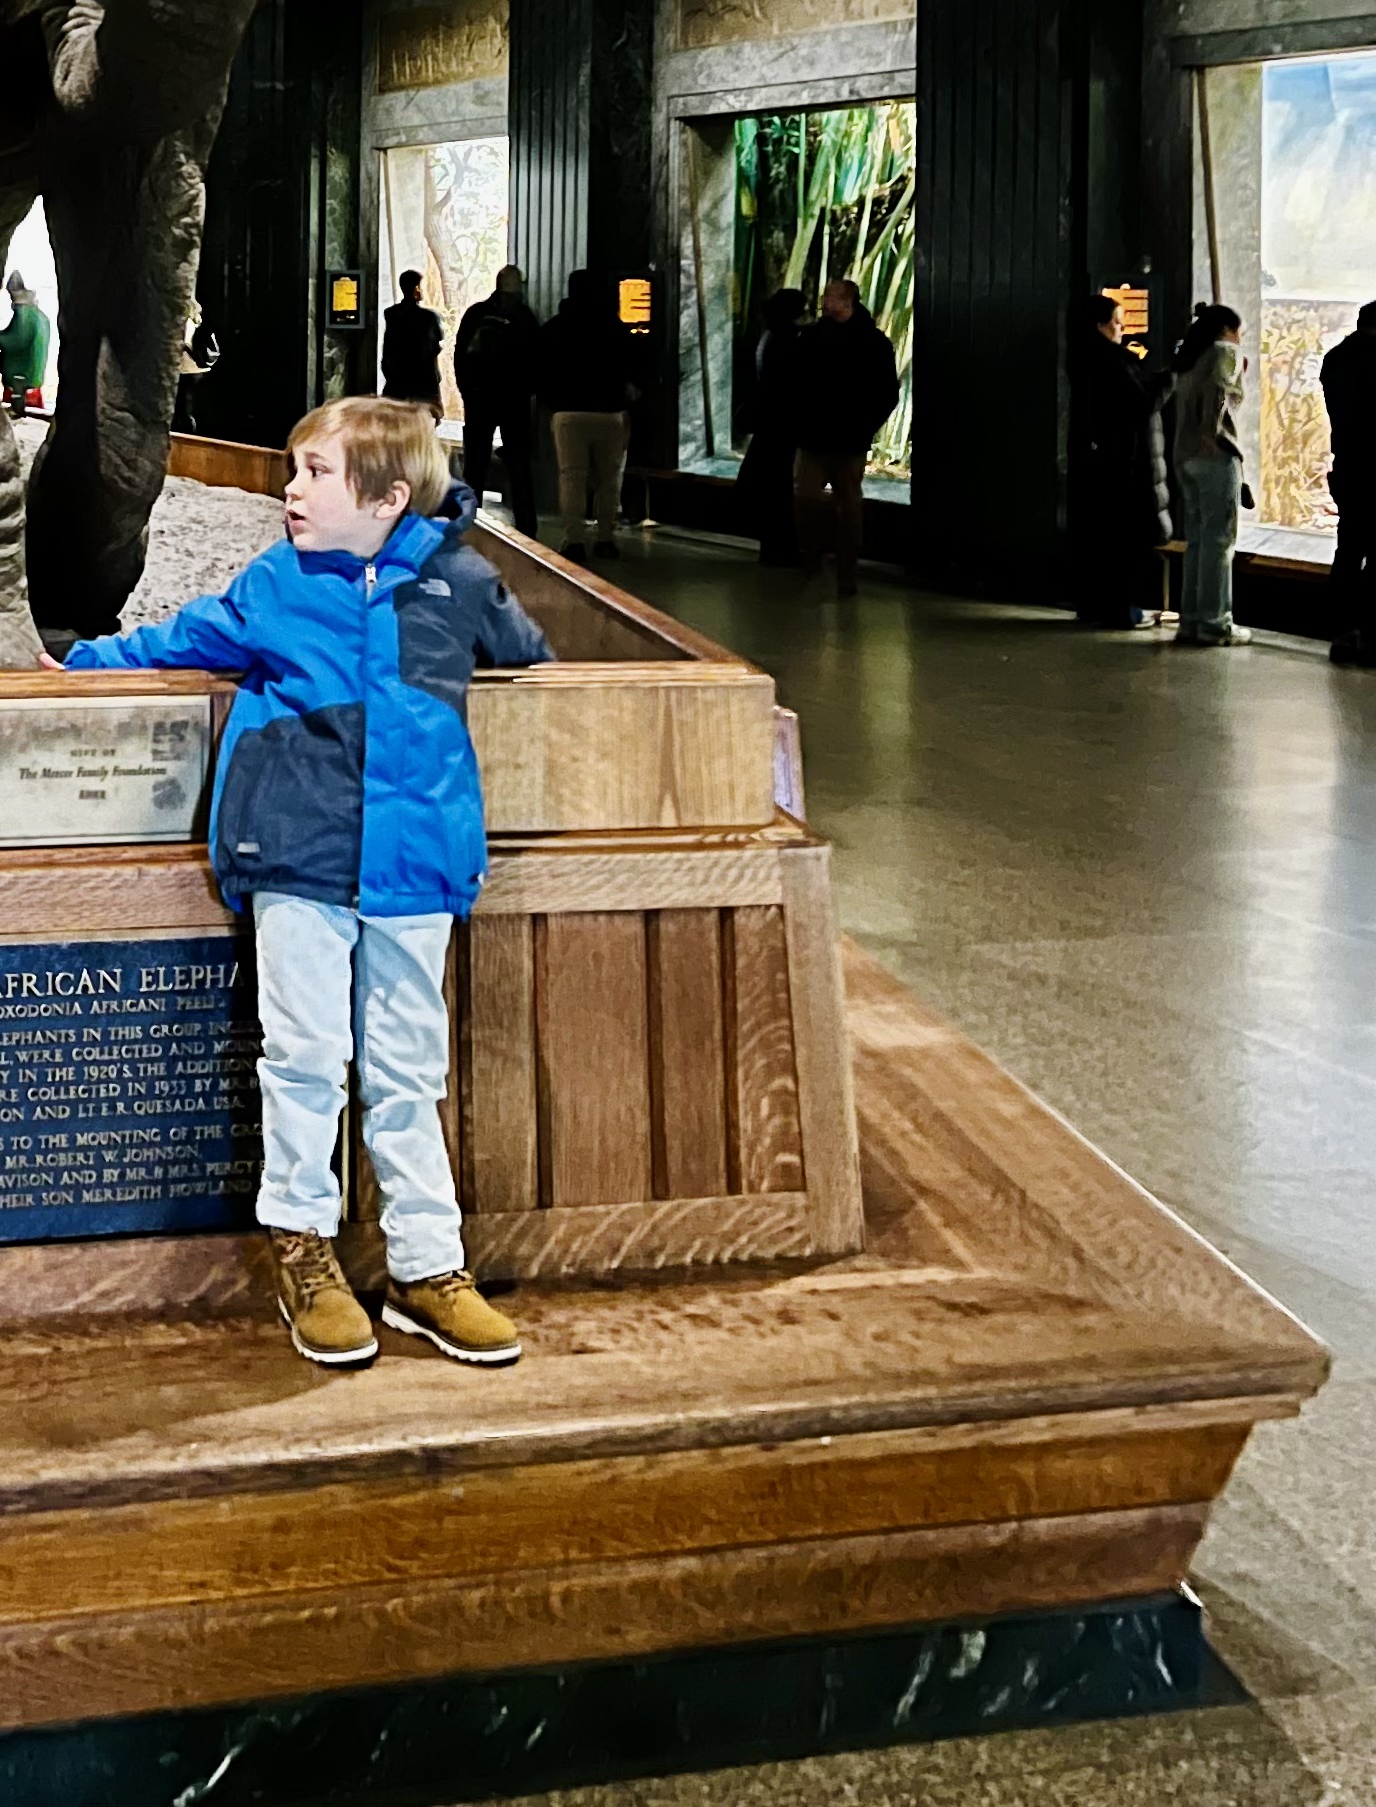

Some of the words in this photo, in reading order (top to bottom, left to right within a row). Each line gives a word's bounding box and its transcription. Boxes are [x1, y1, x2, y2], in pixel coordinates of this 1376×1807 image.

[19, 767, 37, 780] The
[76, 765, 109, 782] Family
[112, 764, 167, 777] Foundation
[139, 962, 245, 992] ELEPHA
[82, 1027, 102, 1042] IN
[108, 1025, 142, 1040] THIS
[15, 1049, 64, 1064] WERE
[72, 1044, 163, 1061] COLLECTED
[169, 1042, 205, 1057] AND
[213, 1039, 261, 1055] MOUN
[18, 1068, 37, 1083] IN
[46, 1066, 77, 1082] THE
[137, 1062, 167, 1077] THE
[175, 1058, 257, 1074] ADDITION
[27, 1083, 121, 1102] COLLECTED
[127, 1081, 147, 1097] IN
[154, 1079, 187, 1097] 1933
[194, 1077, 213, 1093] BY
[32, 1105, 71, 1121] AND
[11, 1135, 33, 1150] TO
[38, 1133, 69, 1149] THE
[76, 1128, 161, 1147] MOUNTING
[169, 1127, 189, 1141] OF
[194, 1124, 224, 1140] THE
[35, 1150, 96, 1168] ROBERT
[60, 1170, 97, 1186] AND
[102, 1168, 122, 1183] BY
[205, 1159, 258, 1177] PERCY
[41, 1189, 74, 1206] SON
[82, 1185, 162, 1203] MEREDITH
[169, 1179, 253, 1199] HOWLAND
